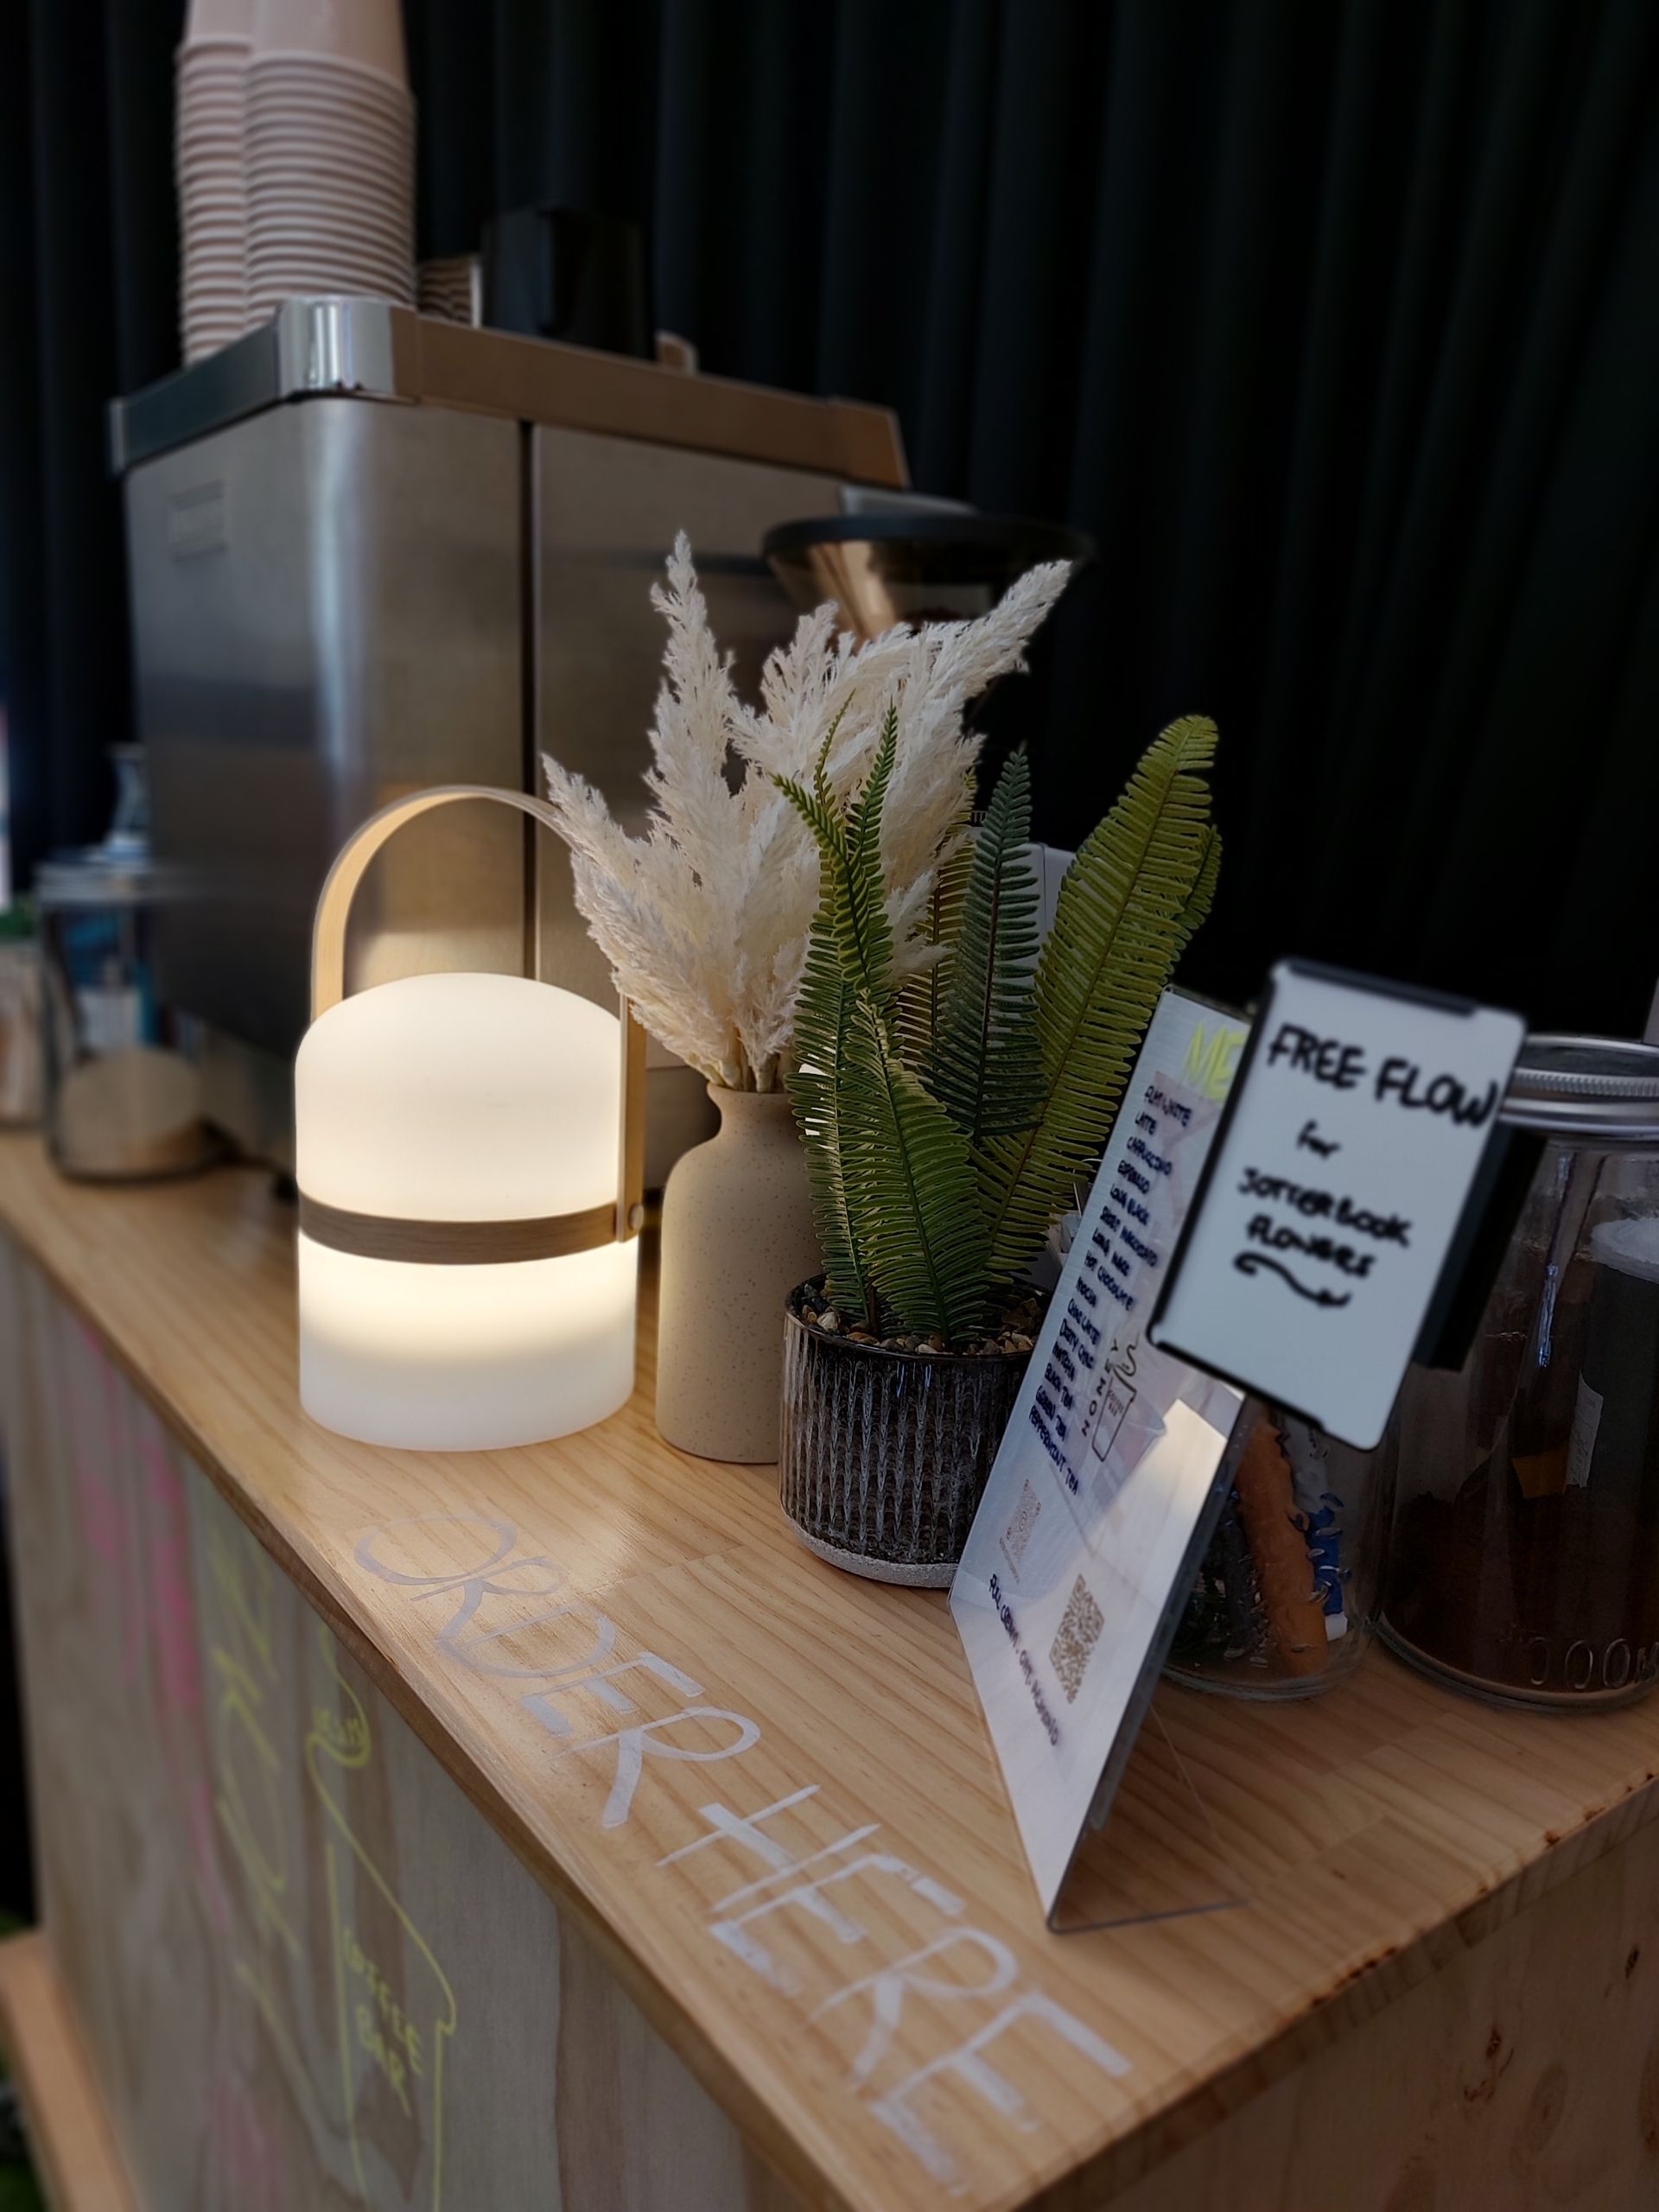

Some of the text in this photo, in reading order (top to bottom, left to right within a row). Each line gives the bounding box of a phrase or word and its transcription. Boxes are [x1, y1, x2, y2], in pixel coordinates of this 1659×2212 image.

[1184, 1022, 1249, 1103] ME
[1267, 1023, 1498, 1128] FREE FLOW
[1135, 1111, 1156, 1135] LATTE
[1127, 1136, 1173, 1176] CAPPUCCINO
[1076, 1276, 1096, 1307] MOCHA
[1096, 1265, 1134, 1312] CHOCOLATE
[1068, 1298, 1083, 1324] CHAI
[1059, 1318, 1079, 1352] DIRTY
[1052, 1341, 1075, 1382] MATCHA
[1060, 1385, 1073, 1410] TEA
[1055, 1414, 1067, 1441] TEA
[1029, 1404, 1079, 1496] PEPPERMINT TEA
[354, 1515, 1131, 2196] ORDER HERE
